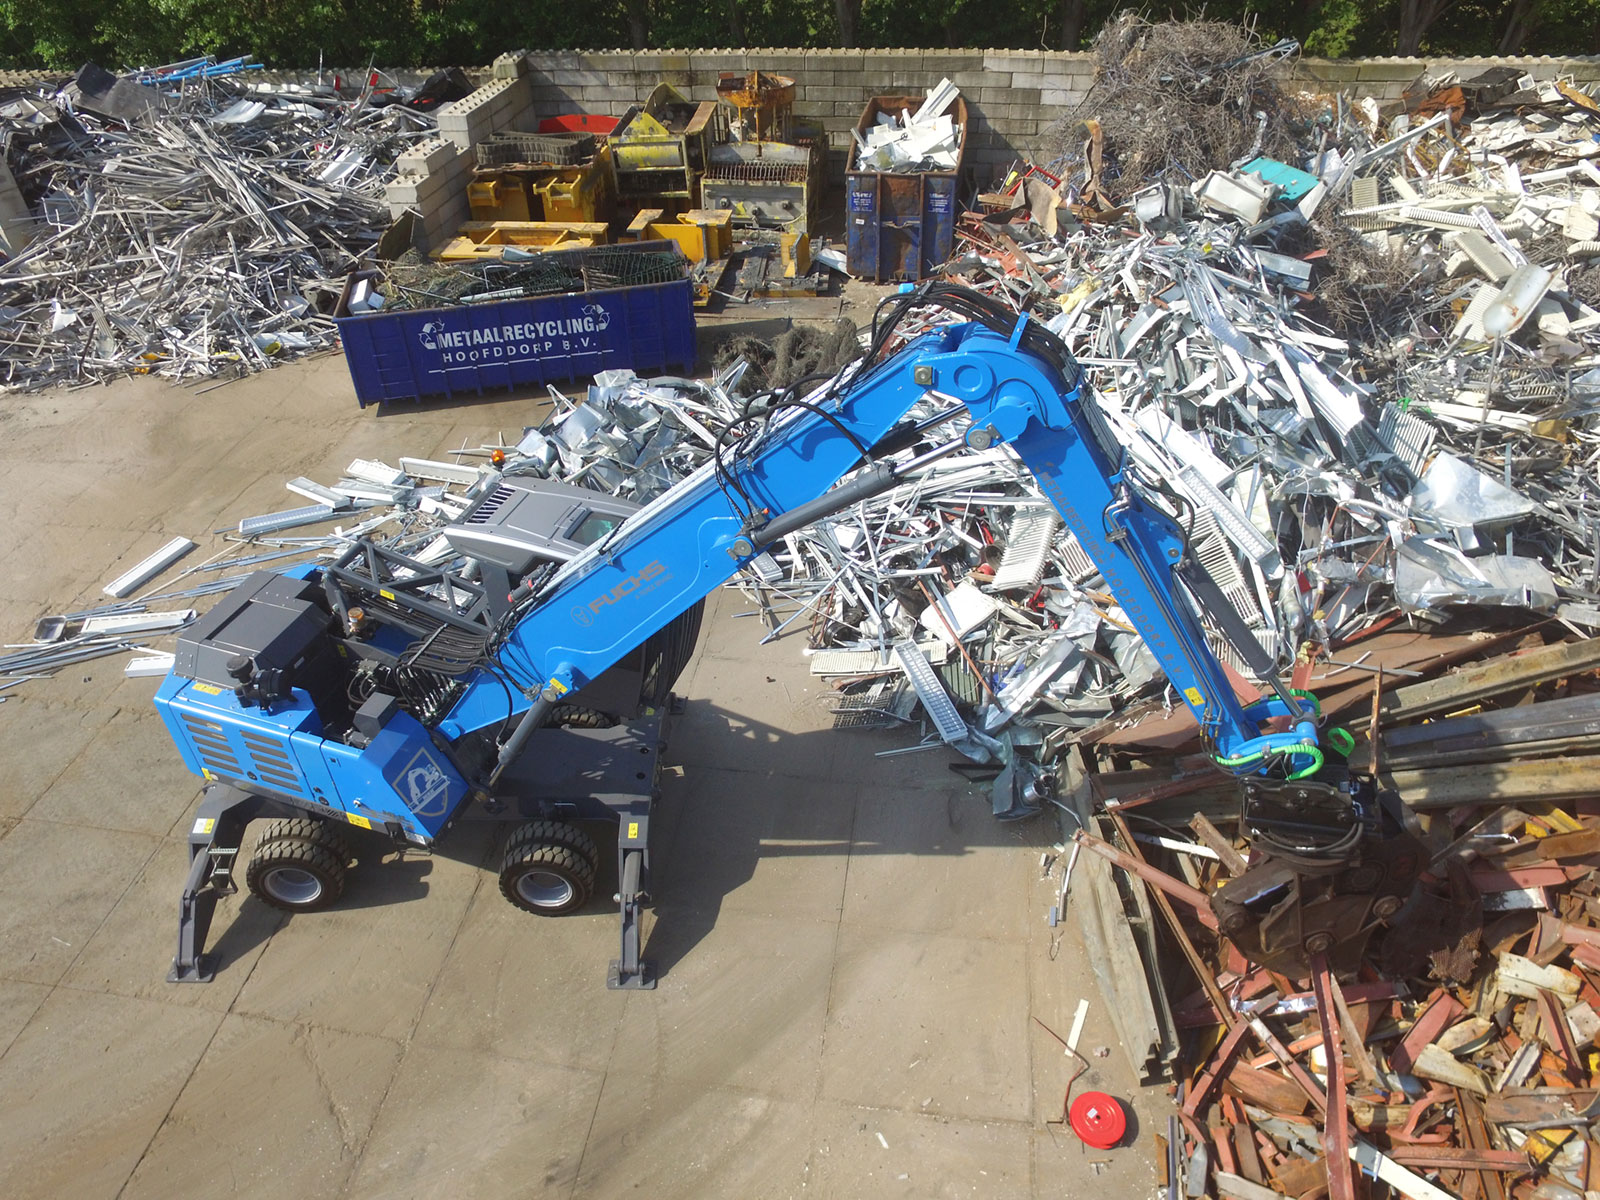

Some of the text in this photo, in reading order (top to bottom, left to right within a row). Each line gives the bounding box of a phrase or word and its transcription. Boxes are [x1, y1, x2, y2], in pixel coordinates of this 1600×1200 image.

[437, 316, 595, 349] METAALRECYCLING
[443, 337, 597, 362] HOOFDDORP B.V.
[588, 559, 666, 615] FUCHS
[1104, 568, 1166, 648] HOOFDDORP
